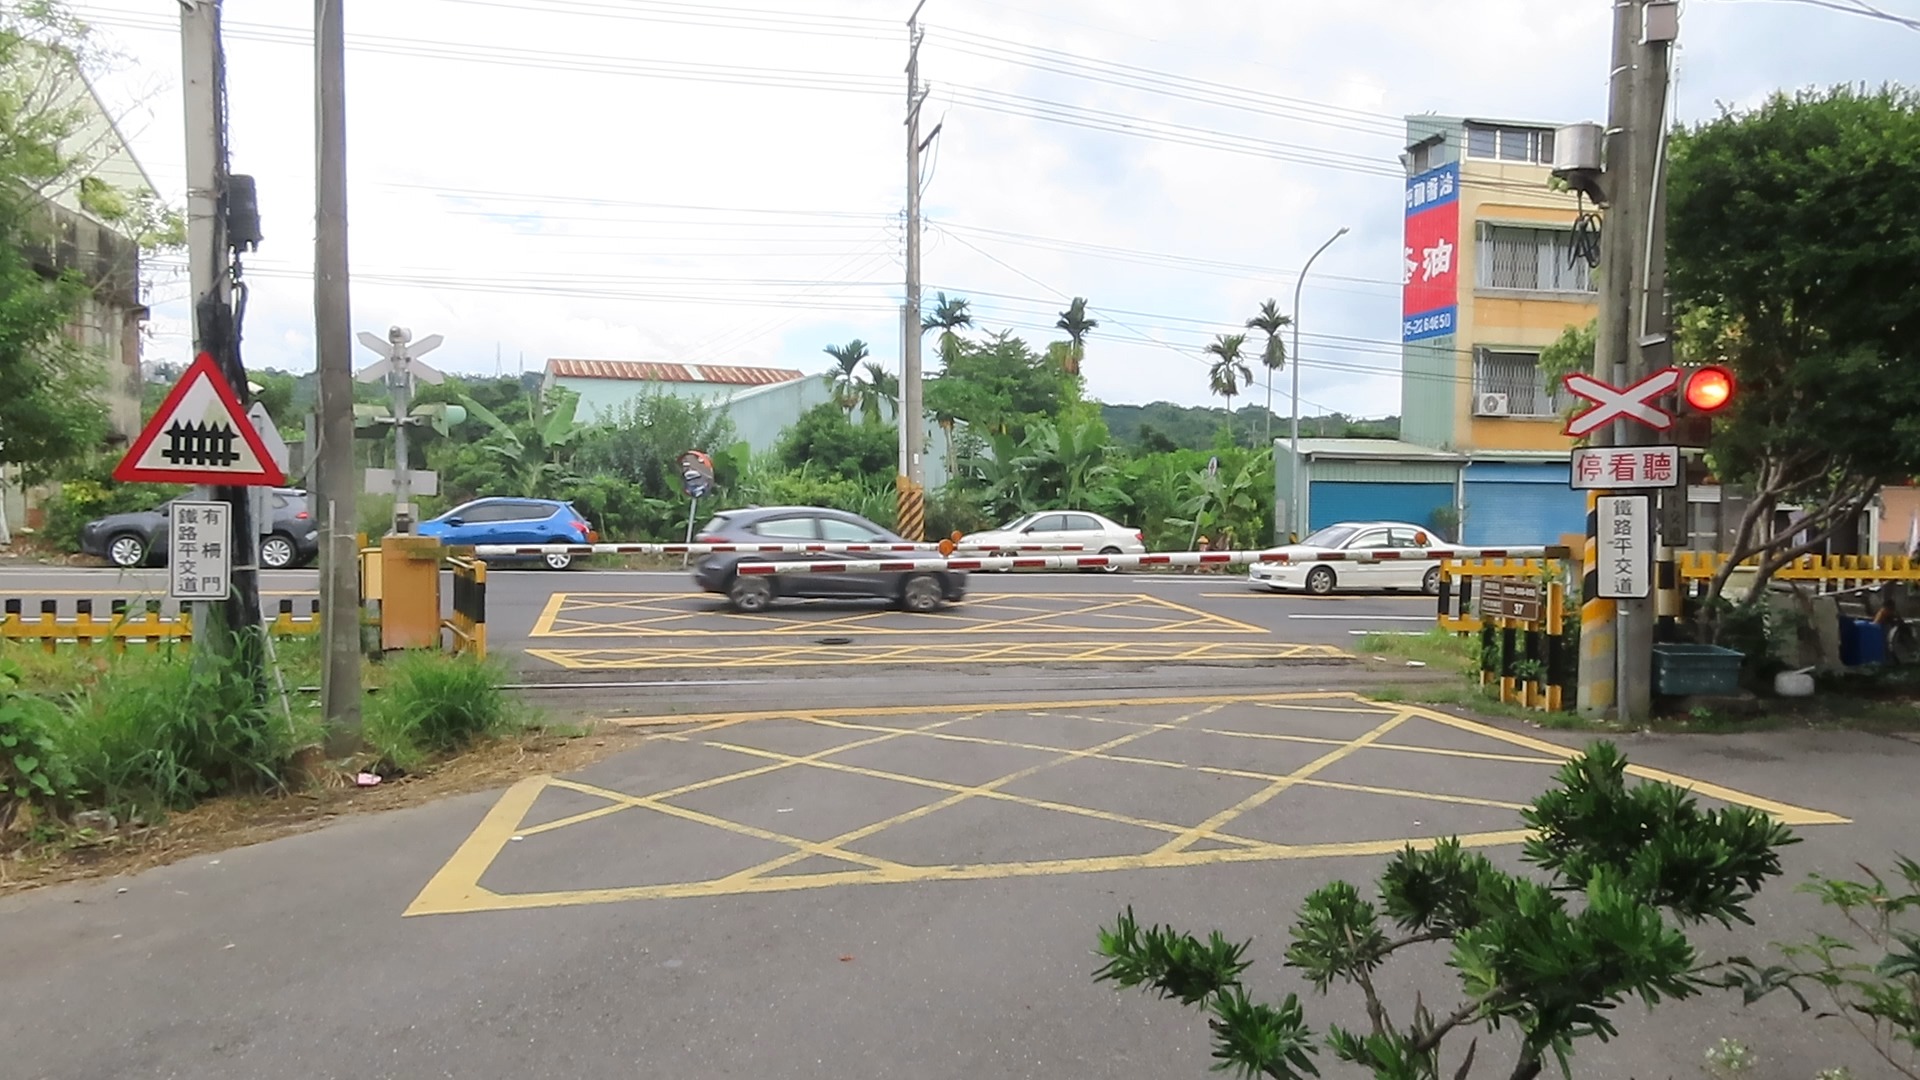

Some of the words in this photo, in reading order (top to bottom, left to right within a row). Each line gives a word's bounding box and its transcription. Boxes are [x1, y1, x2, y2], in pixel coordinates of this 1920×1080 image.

[1576, 453, 1671, 482] 停看聽
[178, 508, 198, 593] 鐵路平交道
[201, 508, 222, 592] 有柵門
[1613, 499, 1633, 594] 鐵路平交道
[1513, 603, 1524, 615] 37
